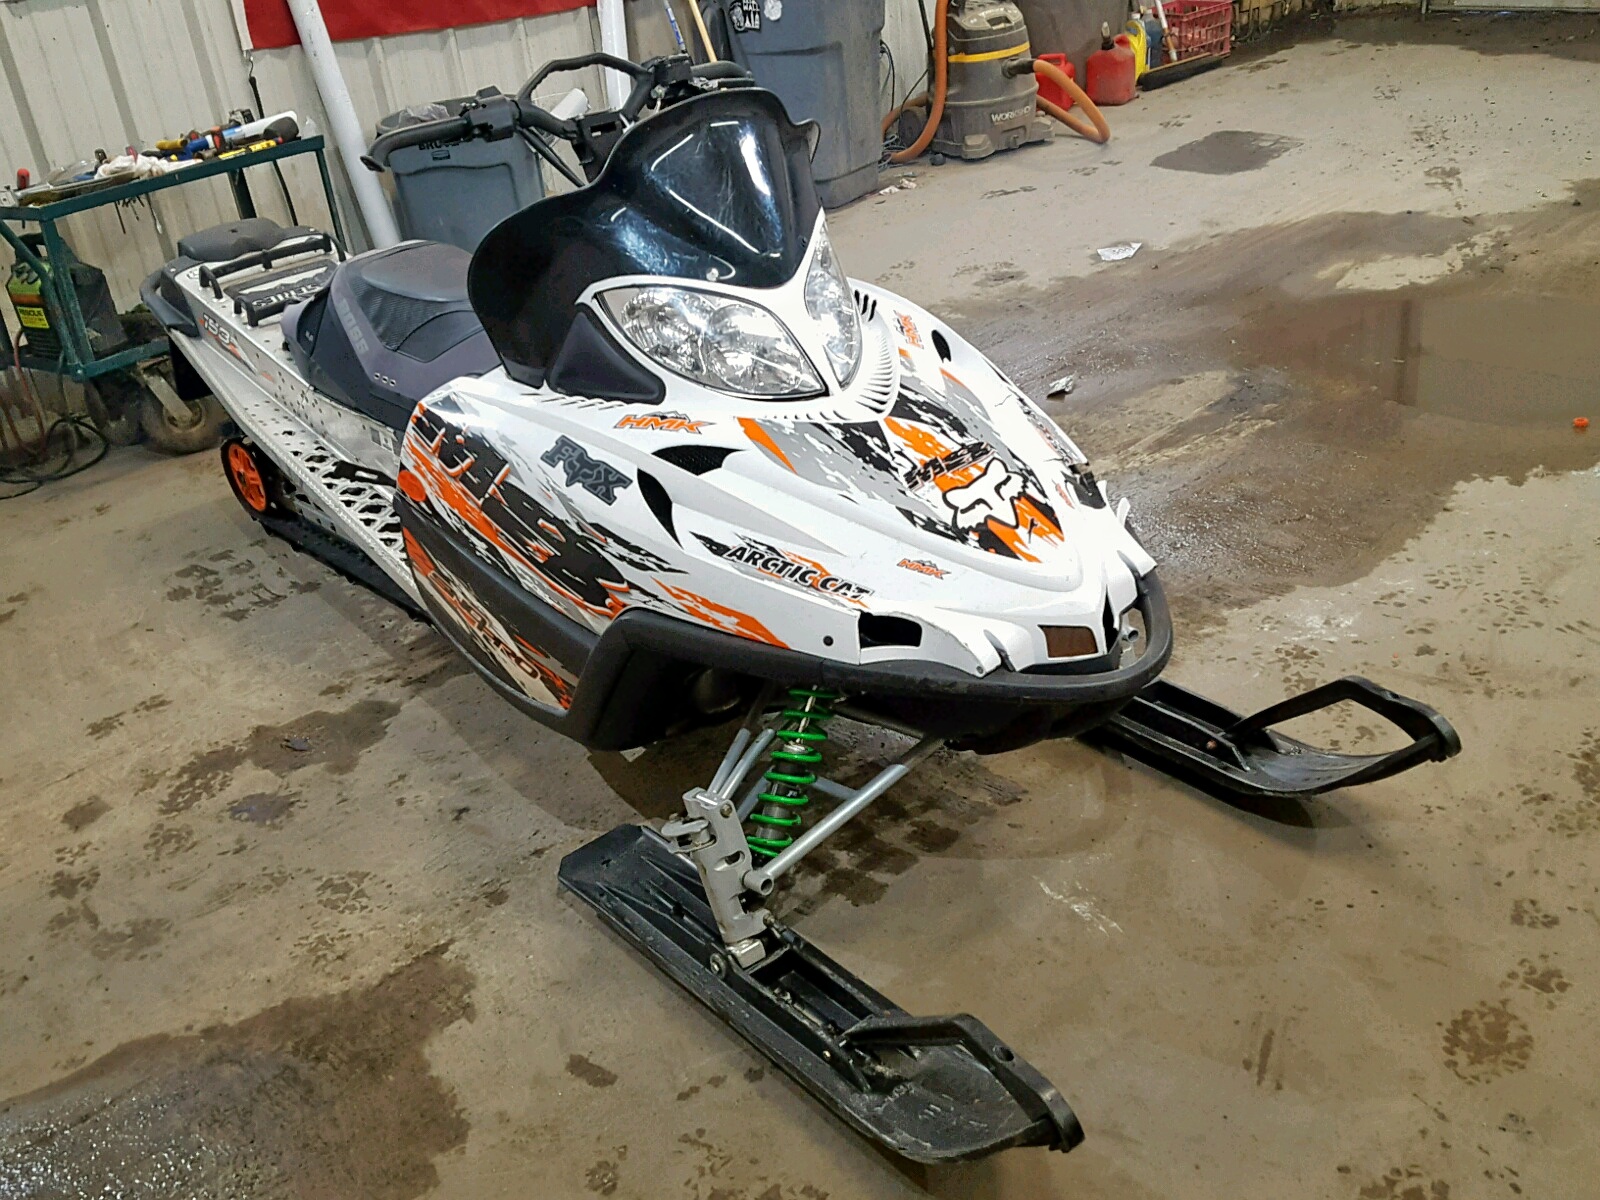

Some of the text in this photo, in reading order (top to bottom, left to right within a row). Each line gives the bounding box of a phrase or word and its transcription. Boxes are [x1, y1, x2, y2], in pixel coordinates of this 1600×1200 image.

[614, 413, 702, 435] HMK
[540, 434, 633, 506] FOX
[724, 545, 875, 602] ARCTIC CAT
[897, 558, 945, 579] HMK
